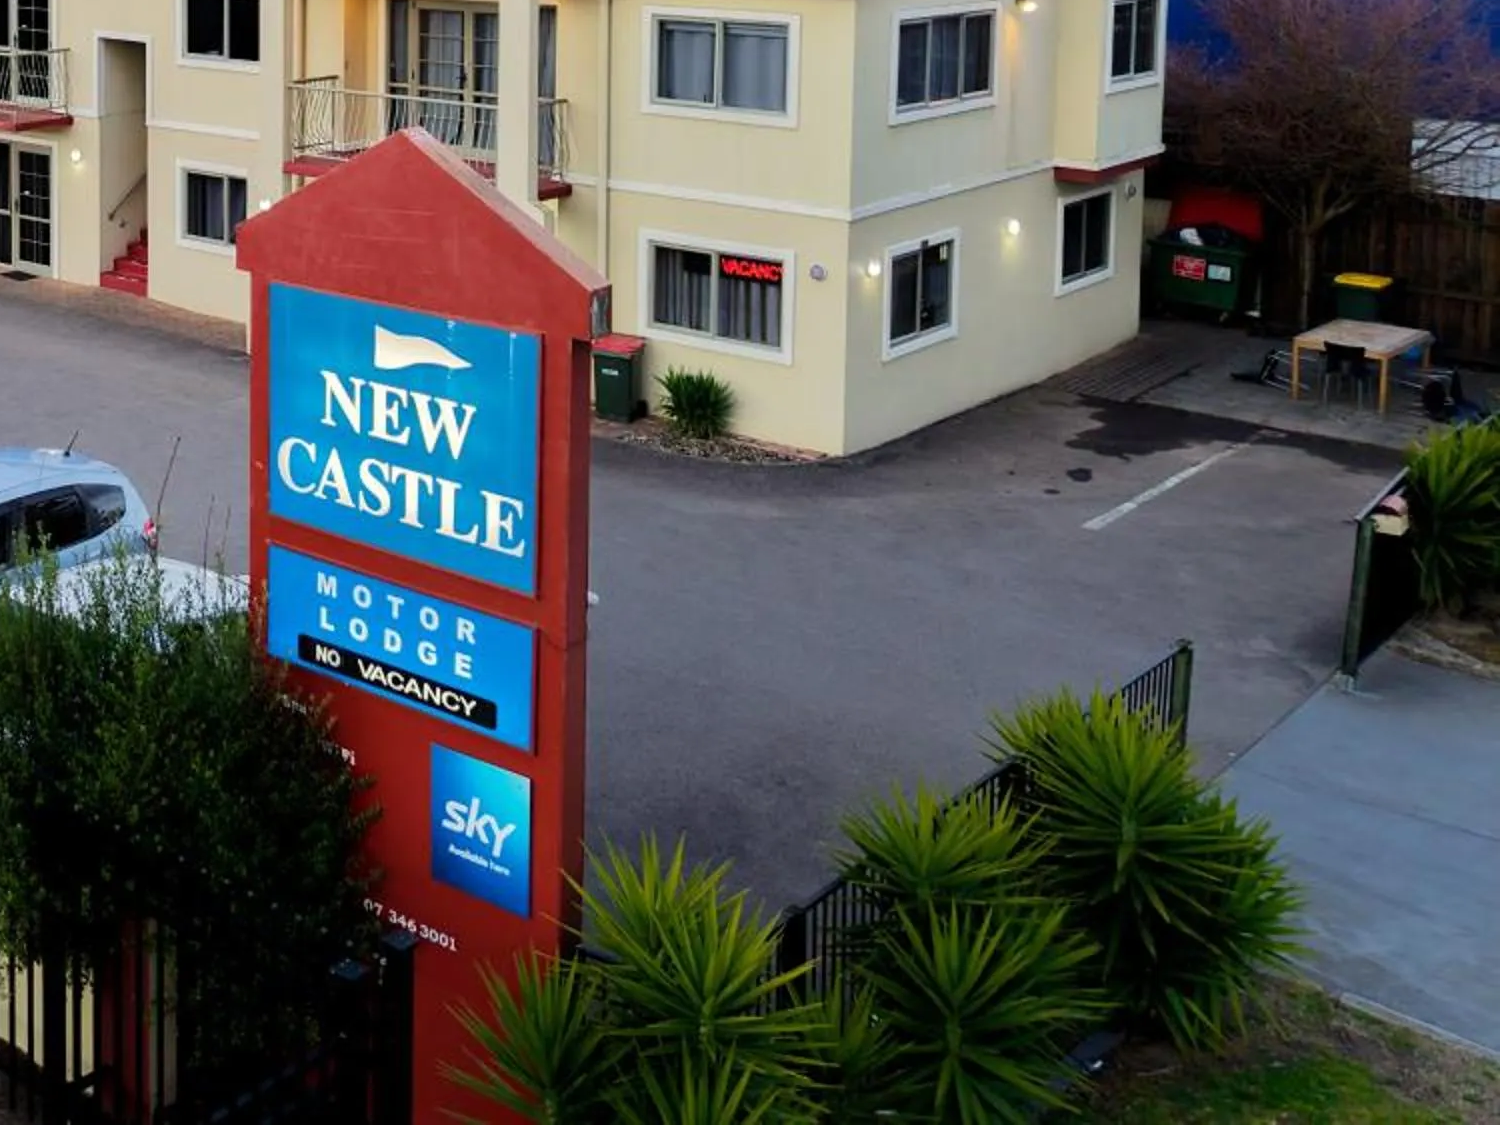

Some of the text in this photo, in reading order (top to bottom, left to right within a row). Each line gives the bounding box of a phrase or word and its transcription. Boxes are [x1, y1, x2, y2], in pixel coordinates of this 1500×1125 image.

[320, 370, 477, 460] NEW
[277, 436, 525, 558] CASTLE
[317, 571, 476, 645] MOTOR
[319, 606, 473, 679] LODGE
[315, 644, 477, 717] NO VACANCY
[363, 898, 457, 952] 07 346 3001
